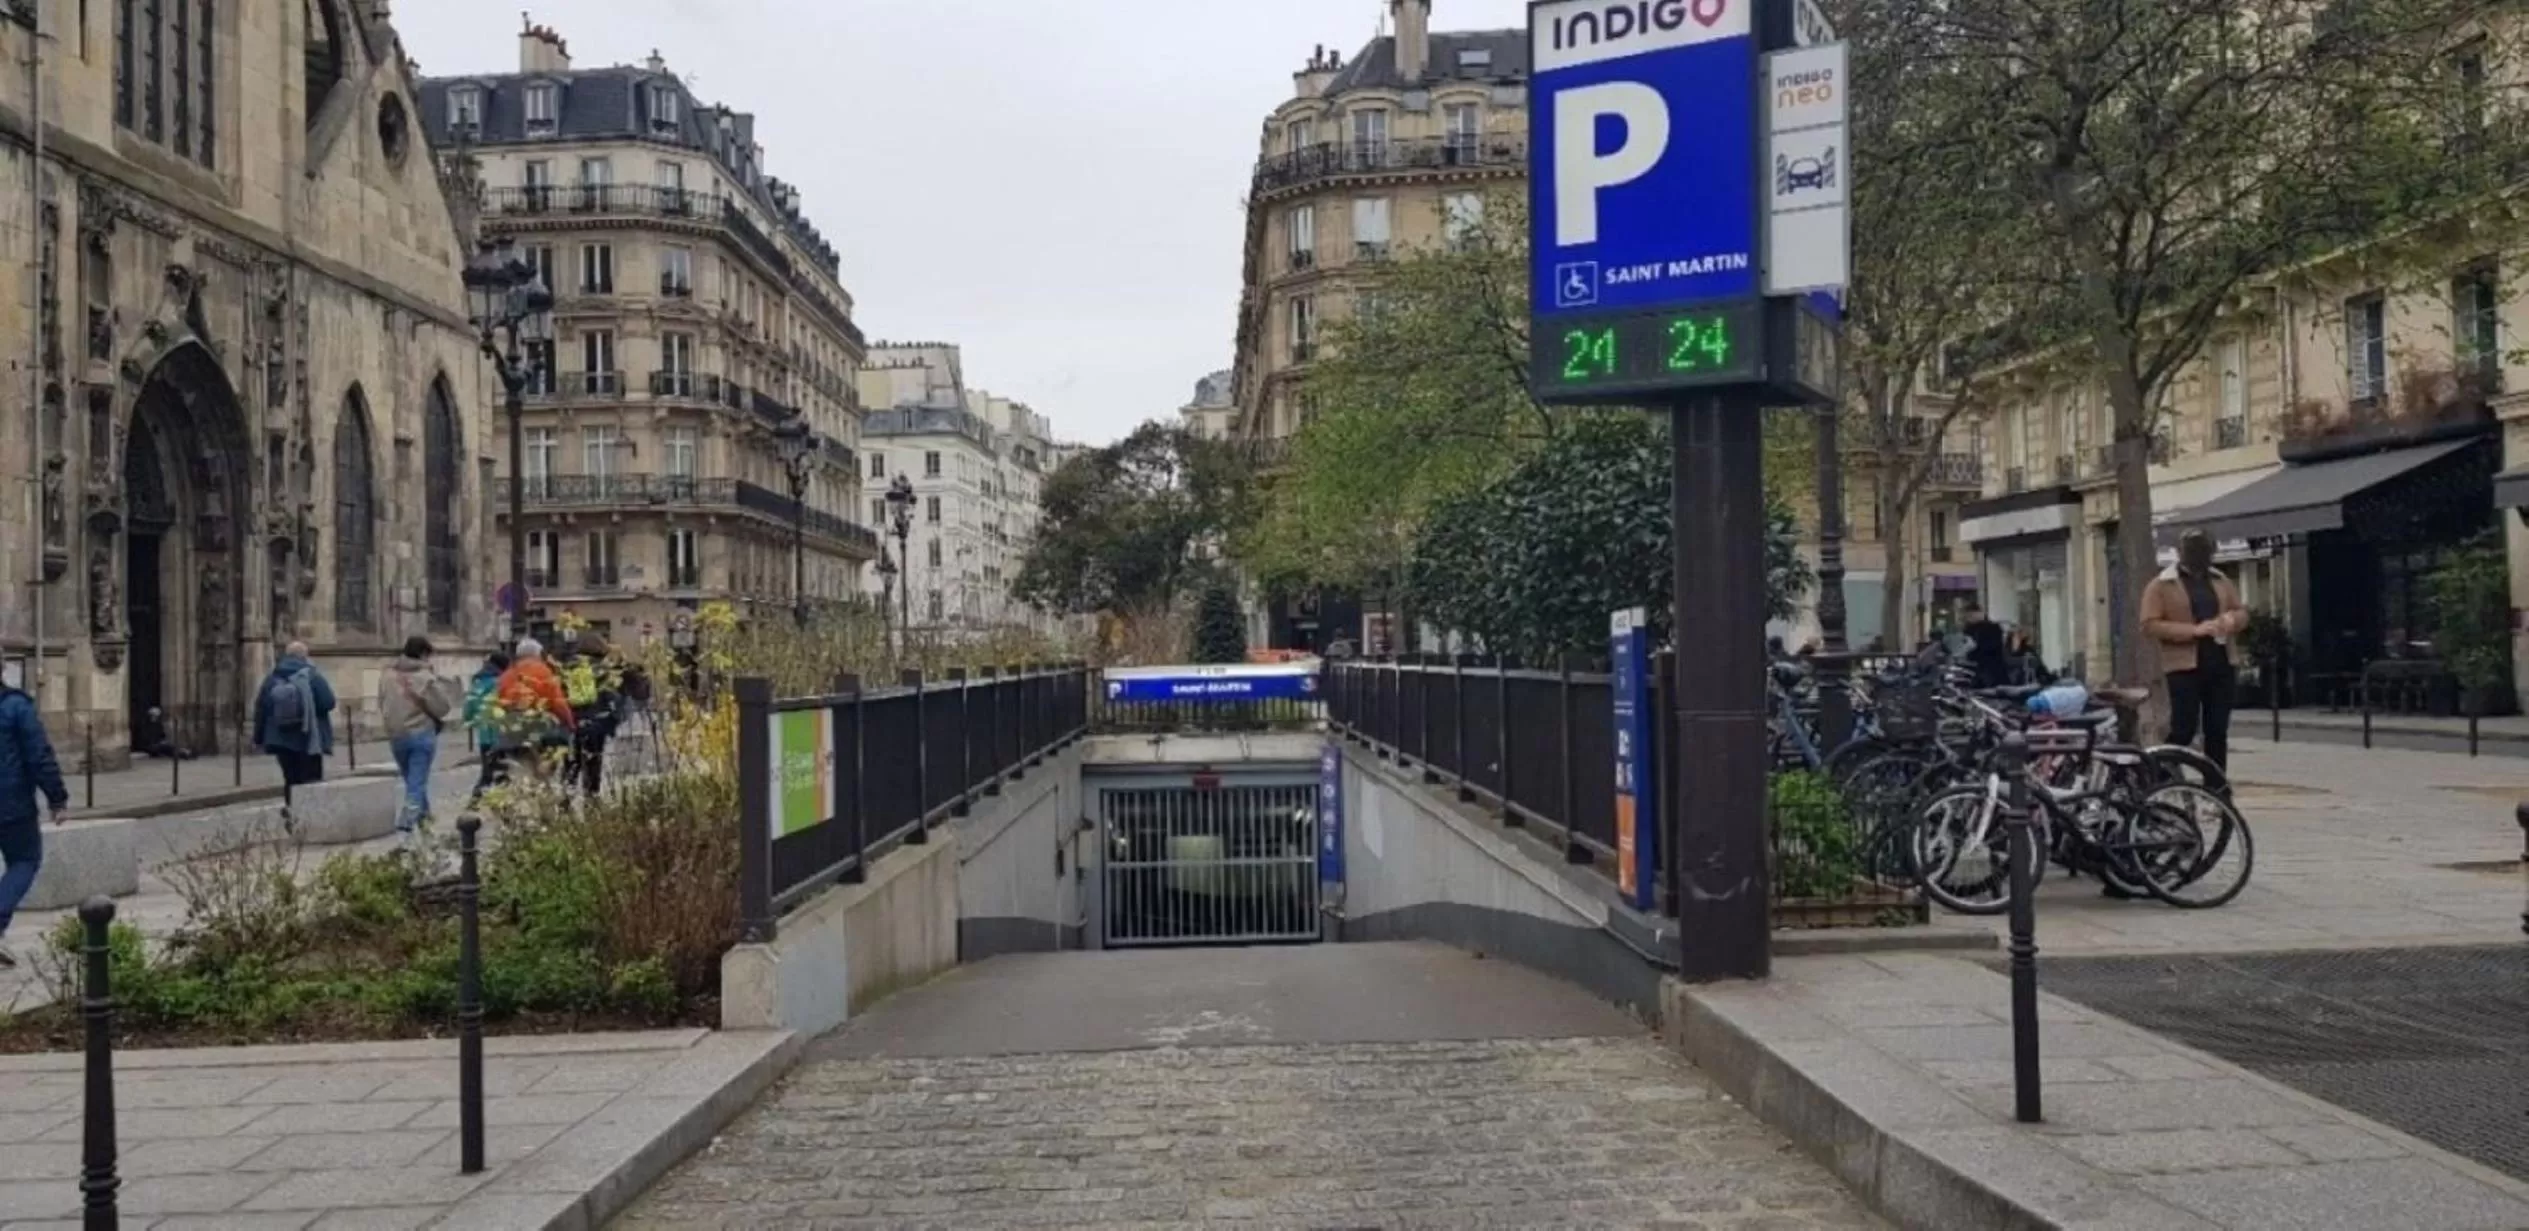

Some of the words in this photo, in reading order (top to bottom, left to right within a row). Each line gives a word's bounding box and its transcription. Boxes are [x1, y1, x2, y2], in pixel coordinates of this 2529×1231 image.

[1553, 0, 1725, 50] INDIGO
[1778, 84, 1832, 108] neo
[1555, 81, 1670, 246] P
[1605, 262, 1662, 284] SAINT
[1668, 252, 1748, 277] MARTIN
[1667, 317, 1729, 368] 24
